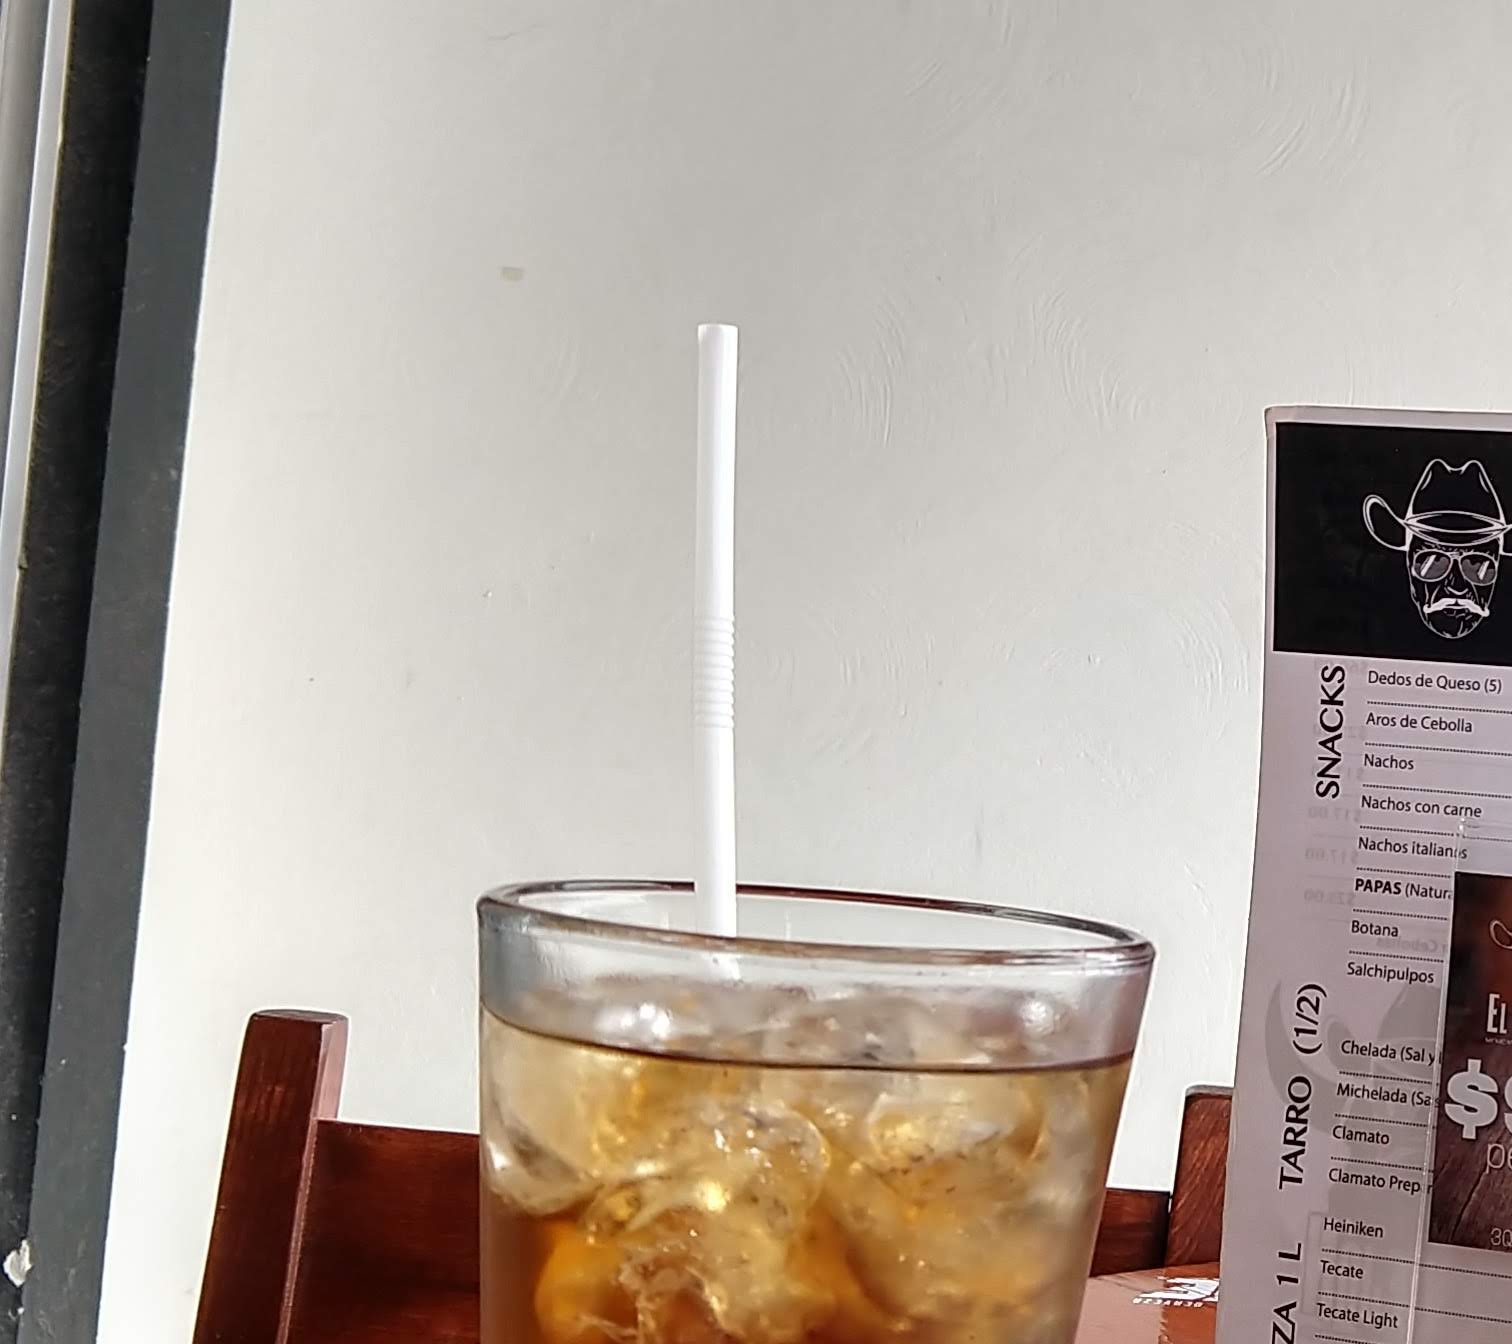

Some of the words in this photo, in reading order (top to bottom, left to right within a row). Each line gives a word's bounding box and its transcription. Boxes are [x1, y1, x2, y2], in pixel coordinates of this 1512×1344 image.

[1367, 670, 1412, 687] Dedos
[1415, 673, 1434, 688] de
[1436, 675, 1481, 692] Queso
[1484, 678, 1503, 695] (5)
[1315, 665, 1346, 799] SNACKS
[1365, 712, 1397, 729] Aros
[1399, 714, 1418, 729] de
[1420, 716, 1473, 733] Cebolla
[1364, 753, 1415, 771] Nachos
[1360, 794, 1412, 813] Nachos
[1414, 801, 1440, 815] con
[1443, 803, 1483, 819] carne
[1357, 836, 1409, 854] Nachos
[1354, 877, 1402, 896] PAPAS
[1350, 919, 1400, 937] Botana
[1346, 960, 1435, 985] Salchipulpos
[1292, 983, 1328, 1056] (1/2)
[1486, 993, 1507, 1034] EL
[1340, 1040, 1397, 1060] Chelada
[1400, 1046, 1426, 1063] (Sal
[1336, 1082, 1408, 1105] Michelada
[1278, 1075, 1313, 1191] TARRO
[1332, 1124, 1390, 1145] Clamato
[1328, 1167, 1386, 1188] Clamato
[1323, 1216, 1385, 1239] Heiniken
[1278, 1242, 1302, 1262] L
[1275, 1273, 1300, 1286] 1
[1319, 1259, 1365, 1280] Tecate
[1315, 1302, 1360, 1324] Tecate
[1363, 1307, 1400, 1331] Light
